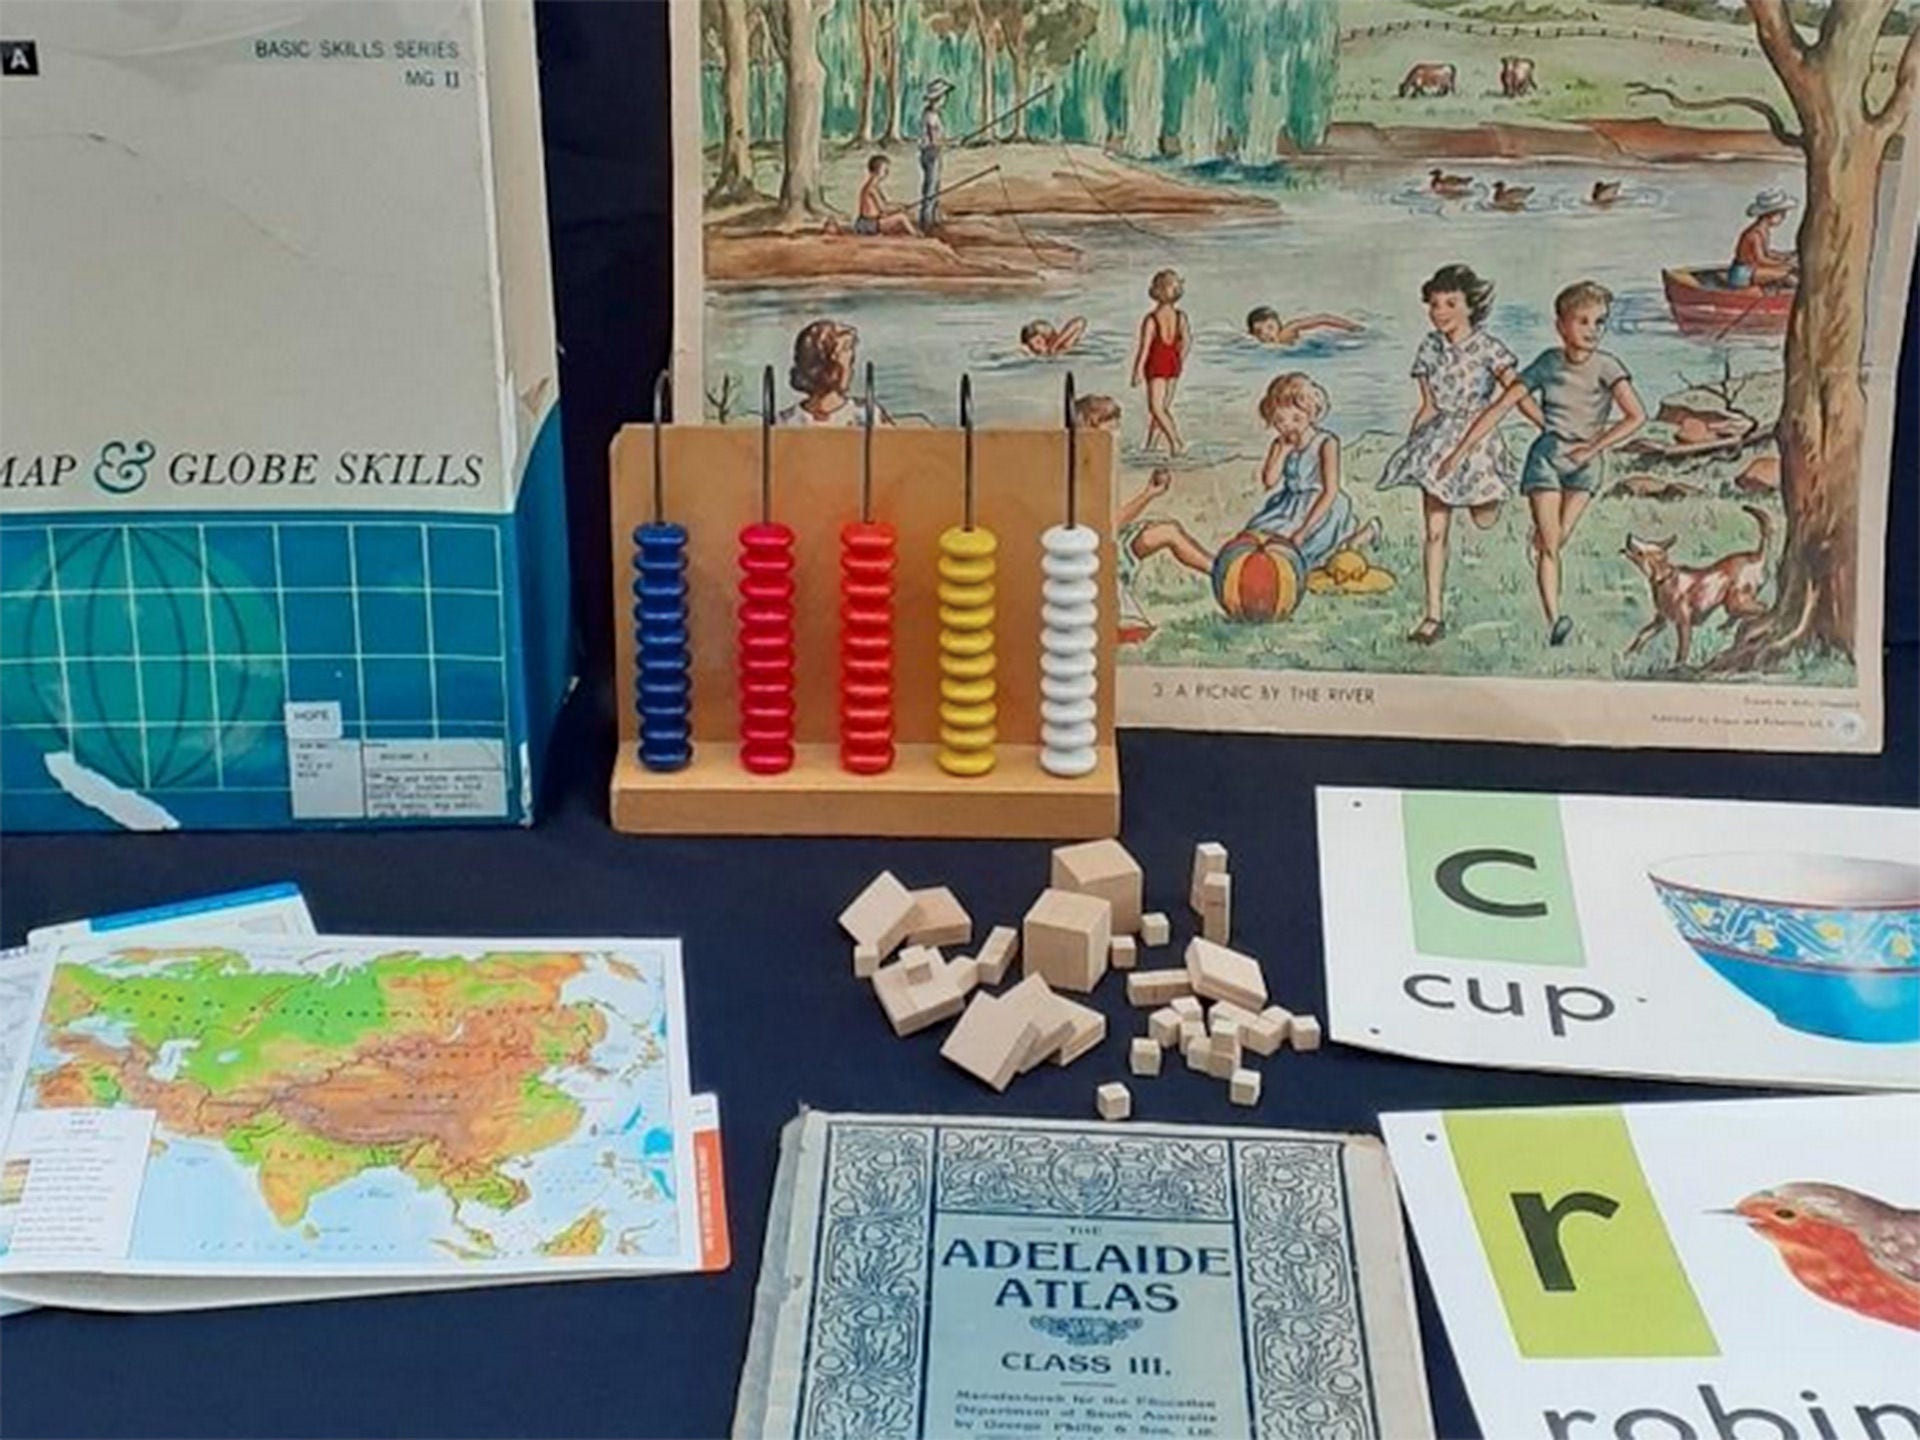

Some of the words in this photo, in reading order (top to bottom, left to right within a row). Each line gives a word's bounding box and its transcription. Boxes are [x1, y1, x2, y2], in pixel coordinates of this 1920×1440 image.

[255, 40, 310, 58] BASIC
[319, 40, 385, 58] SKILLS
[394, 40, 459, 58] SERIES
[405, 70, 434, 87] MG
[94, 440, 156, 494] &
[169, 452, 319, 486] GLOBE
[335, 452, 484, 487] SKILLS
[1175, 684, 1188, 698] A
[1196, 683, 1252, 700] PICNIC
[1260, 685, 1280, 701] BY
[1290, 685, 1320, 702] THE
[1328, 687, 1375, 704] RIVER
[1435, 848, 1548, 919] c
[1403, 973, 1615, 1038] cup
[1066, 1225, 1102, 1236] THE
[1511, 1190, 1620, 1292] r
[942, 1238, 1232, 1277] ADELAIDE
[994, 1278, 1180, 1314] ATLAS
[1001, 1352, 1112, 1374] CLASS
[1102, 1395, 1129, 1405] the
[955, 1403, 1050, 1417] Department
[1060, 1408, 1076, 1418] of
[1085, 1408, 1133, 1420] South
[1142, 1410, 1218, 1423] Australia
[954, 1418, 974, 1430] by
